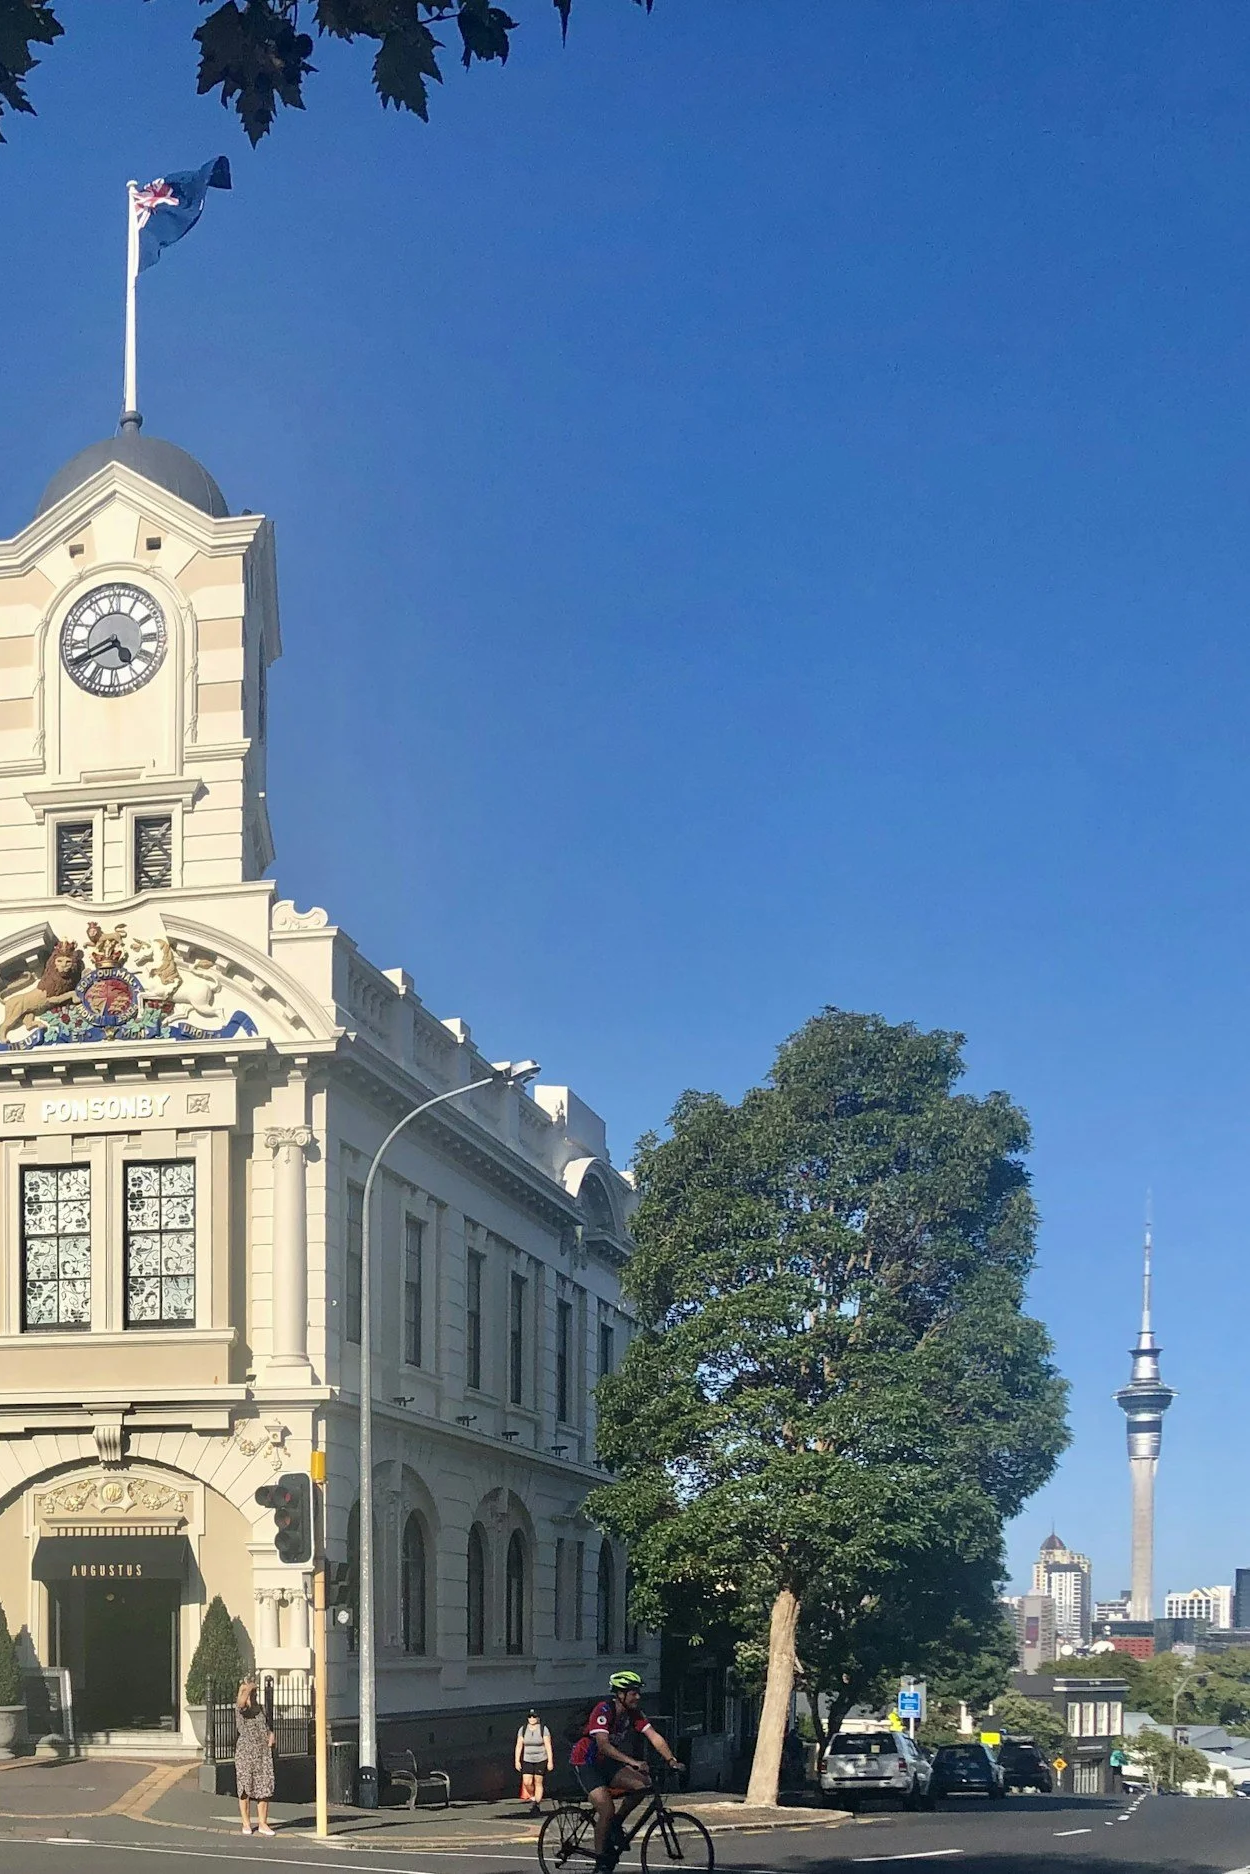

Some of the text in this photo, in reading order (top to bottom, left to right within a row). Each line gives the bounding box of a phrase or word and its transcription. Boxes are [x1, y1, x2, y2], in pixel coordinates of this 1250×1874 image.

[77, 974, 93, 993] SOIT
[116, 970, 135, 984] MAL
[72, 1031, 86, 1043] ET
[183, 1025, 216, 1040] DROIT
[42, 1096, 171, 1124] PONSONBY
[71, 1564, 142, 1577] AUGUSTUS
